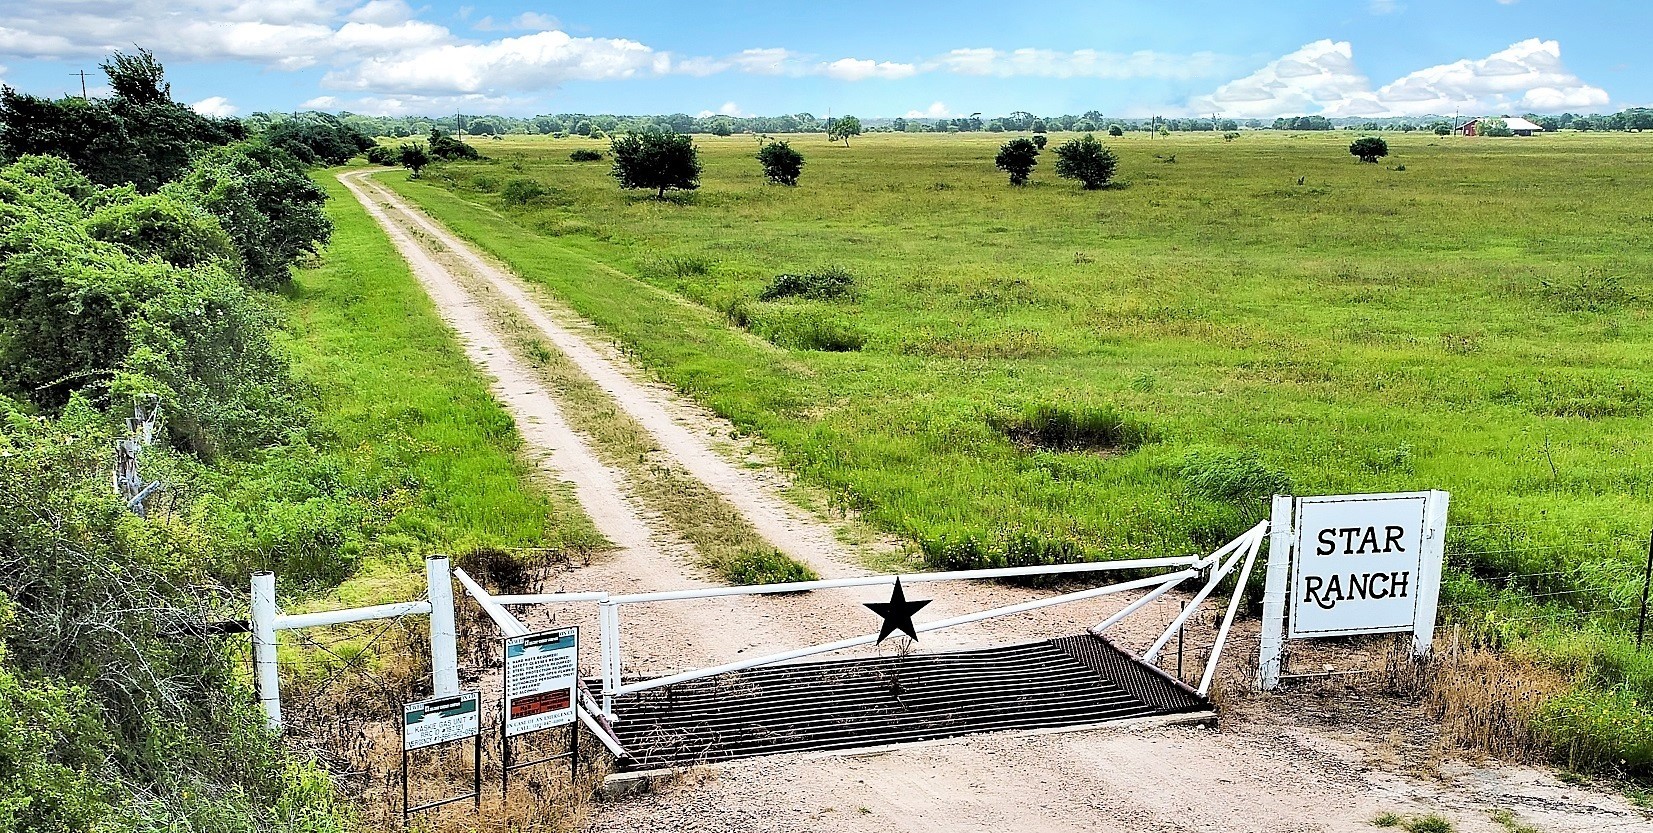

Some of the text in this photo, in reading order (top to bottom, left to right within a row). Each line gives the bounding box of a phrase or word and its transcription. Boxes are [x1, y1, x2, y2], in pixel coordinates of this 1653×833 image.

[1317, 526, 1405, 556] STAR
[1304, 571, 1409, 609] RANCH
[526, 668, 551, 676] PROTECTION
[513, 679, 537, 687] AUTHORIZED
[544, 711, 572, 721] EMERGENCY
[415, 723, 436, 733] KASKIE
[439, 720, 451, 728] GAS
[454, 717, 466, 725] UNIT
